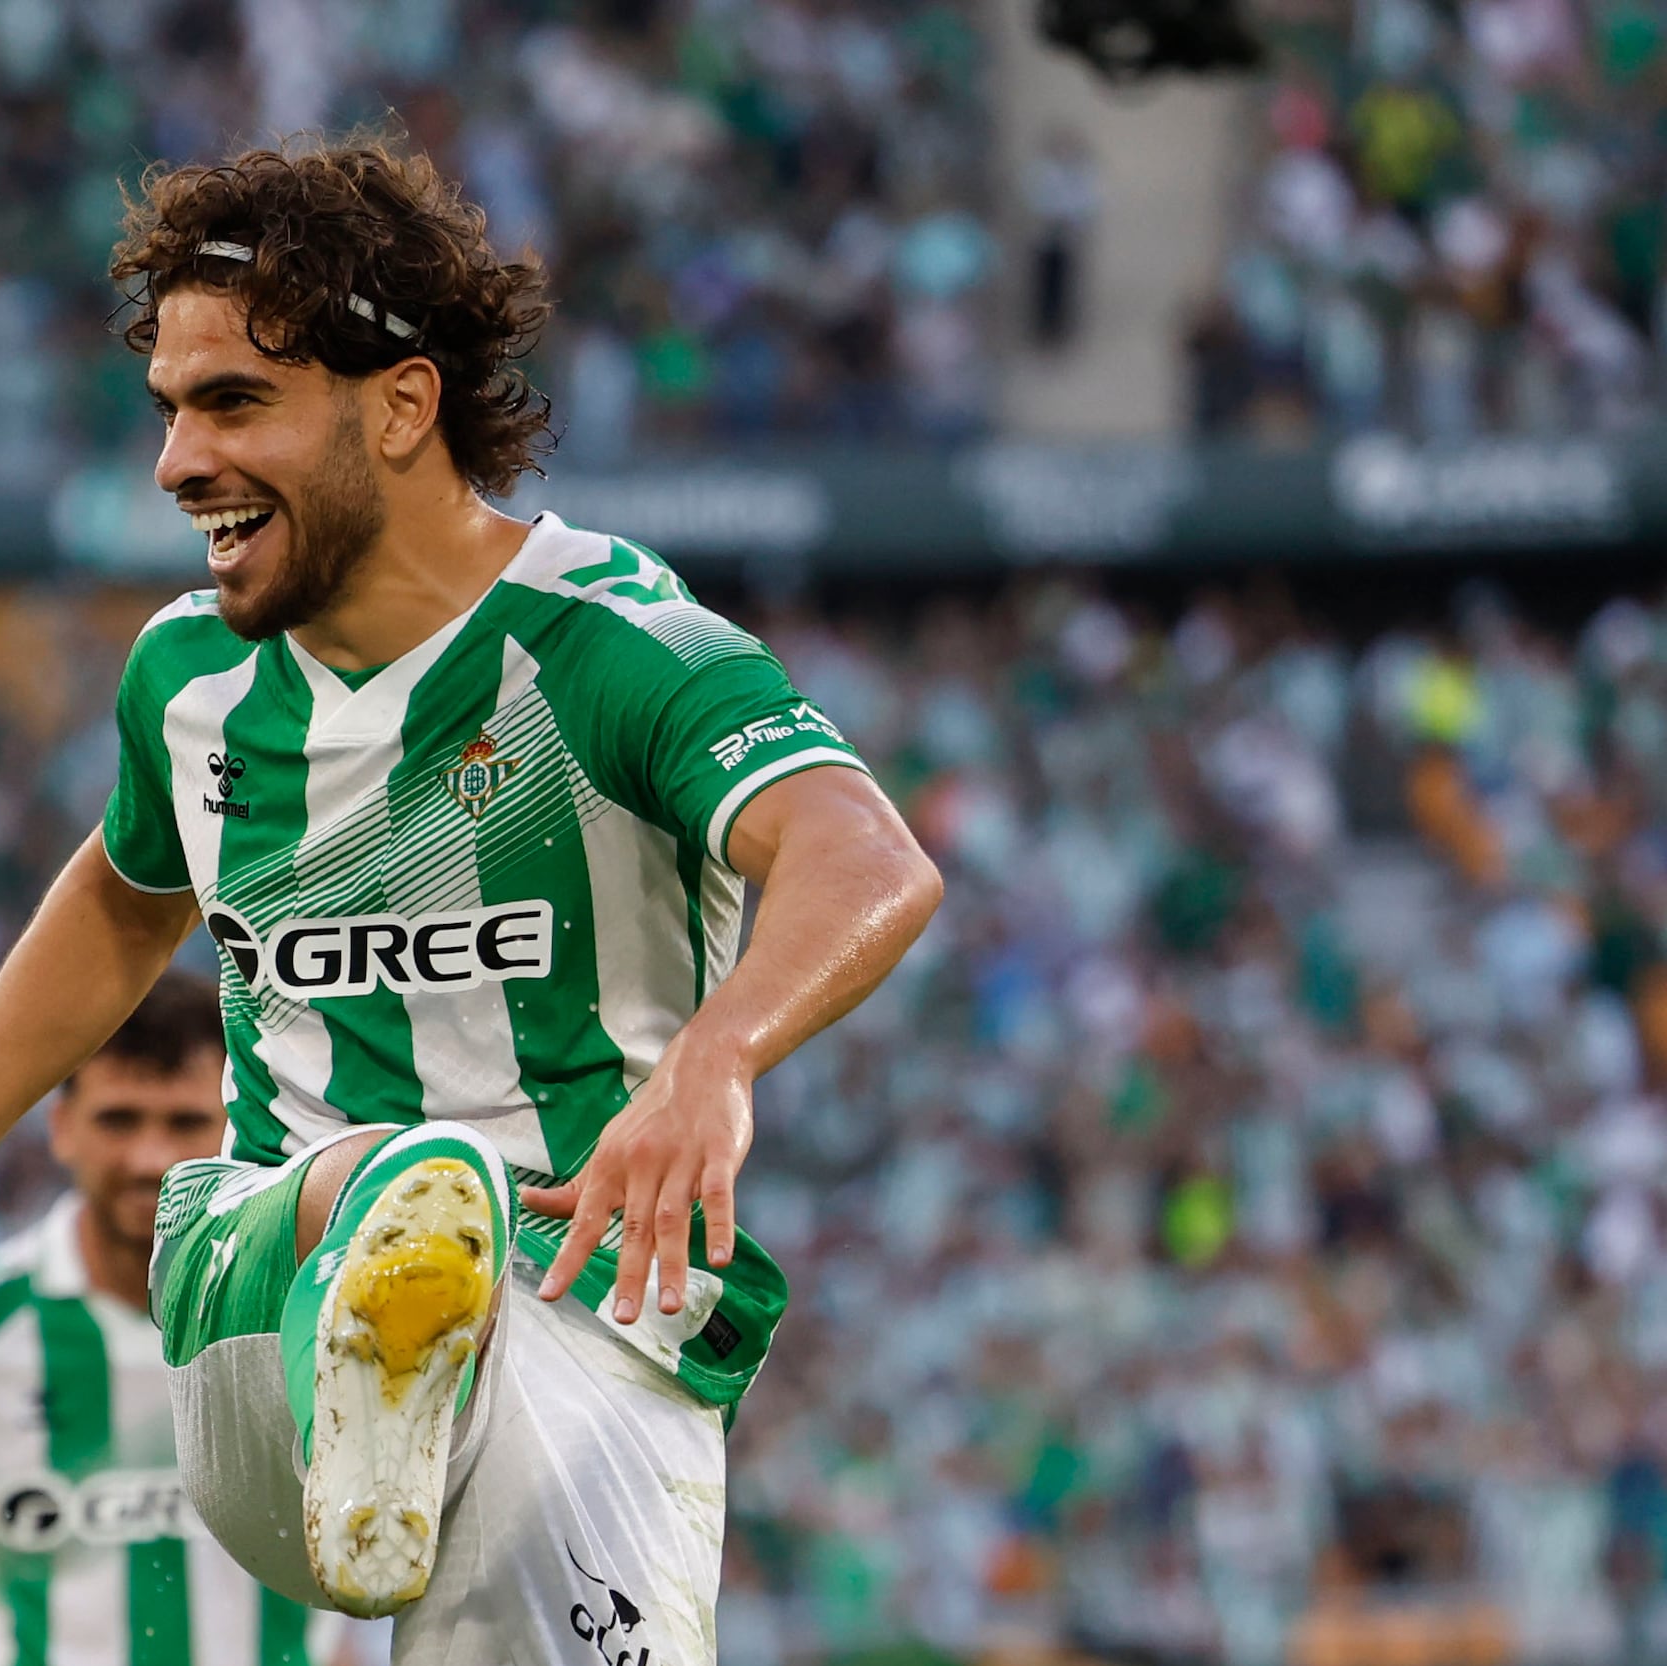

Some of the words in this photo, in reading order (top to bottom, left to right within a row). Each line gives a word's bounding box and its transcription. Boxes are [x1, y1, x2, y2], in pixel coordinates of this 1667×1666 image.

[721, 726, 795, 771] RENTING
[203, 793, 250, 819] hummel
[274, 910, 542, 987] GREE
